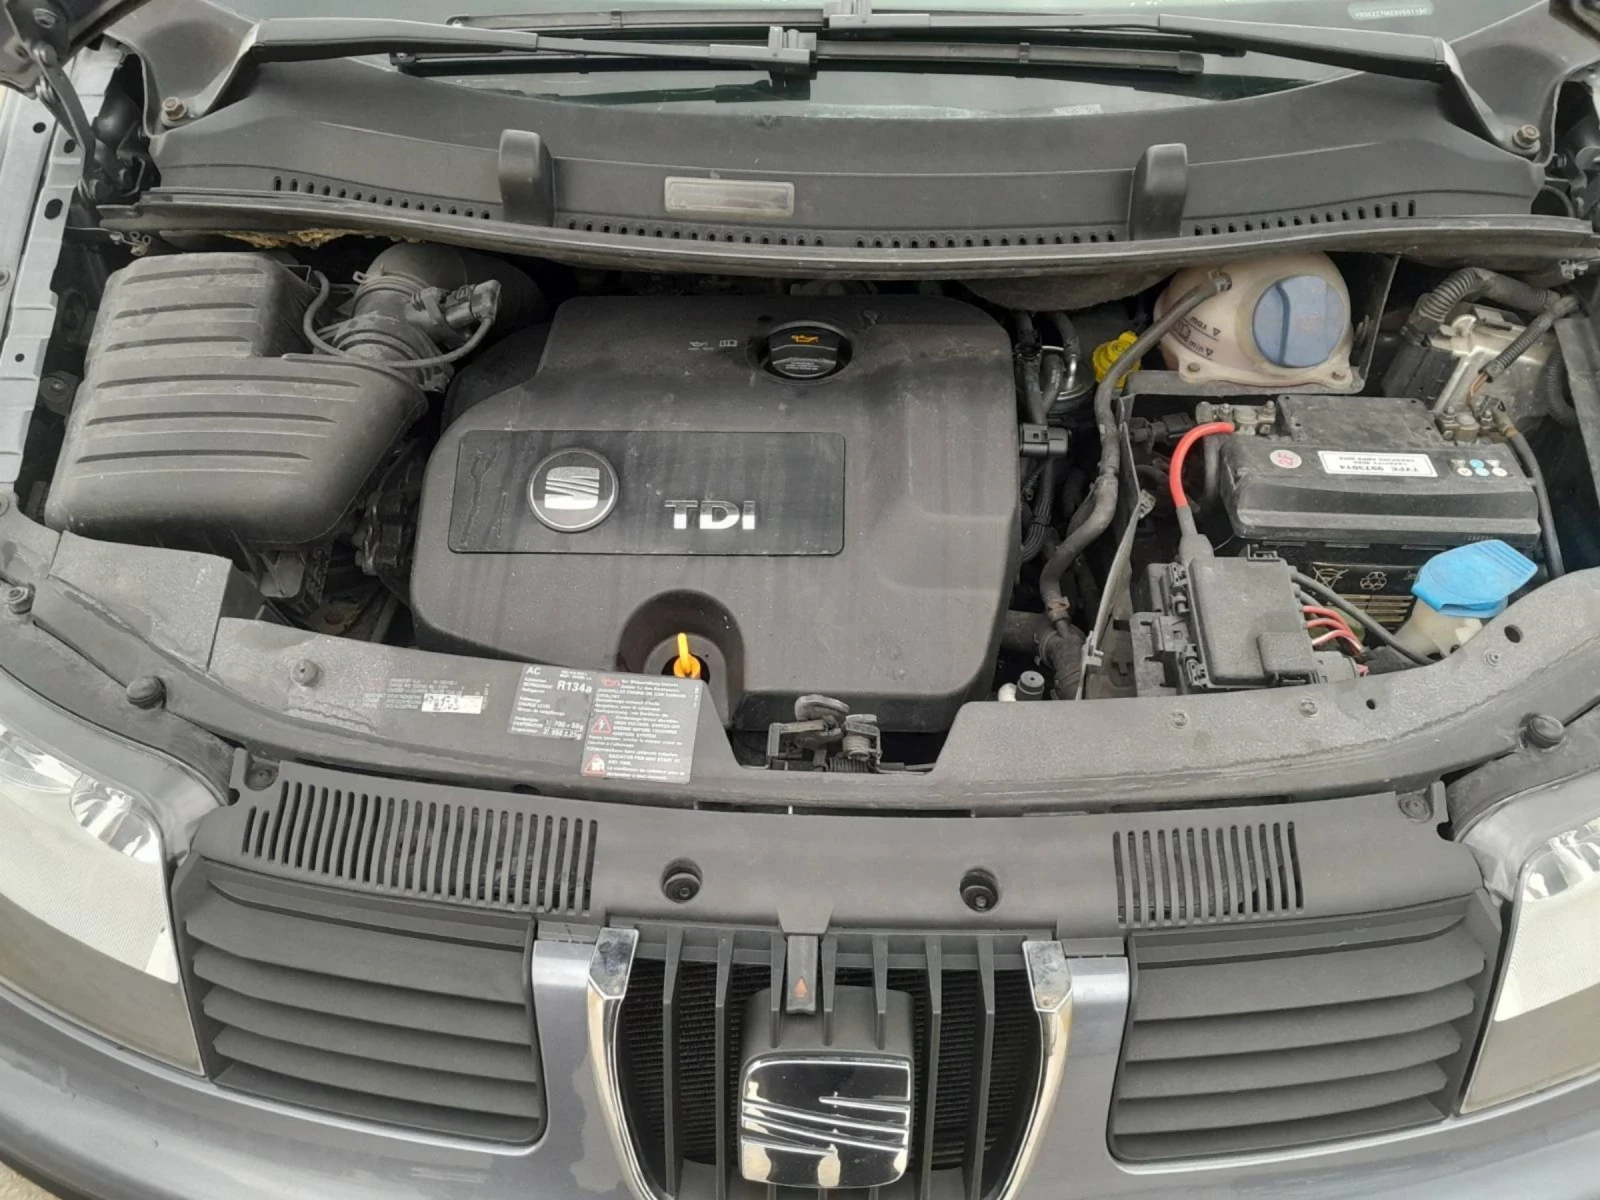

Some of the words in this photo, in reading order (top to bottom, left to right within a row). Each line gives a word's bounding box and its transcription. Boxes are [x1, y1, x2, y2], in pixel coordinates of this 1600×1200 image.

[1190, 316, 1207, 329] max
[1188, 340, 1204, 352] min
[664, 500, 756, 530] TDI
[526, 666, 541, 675] AC
[557, 680, 592, 693] R134a
